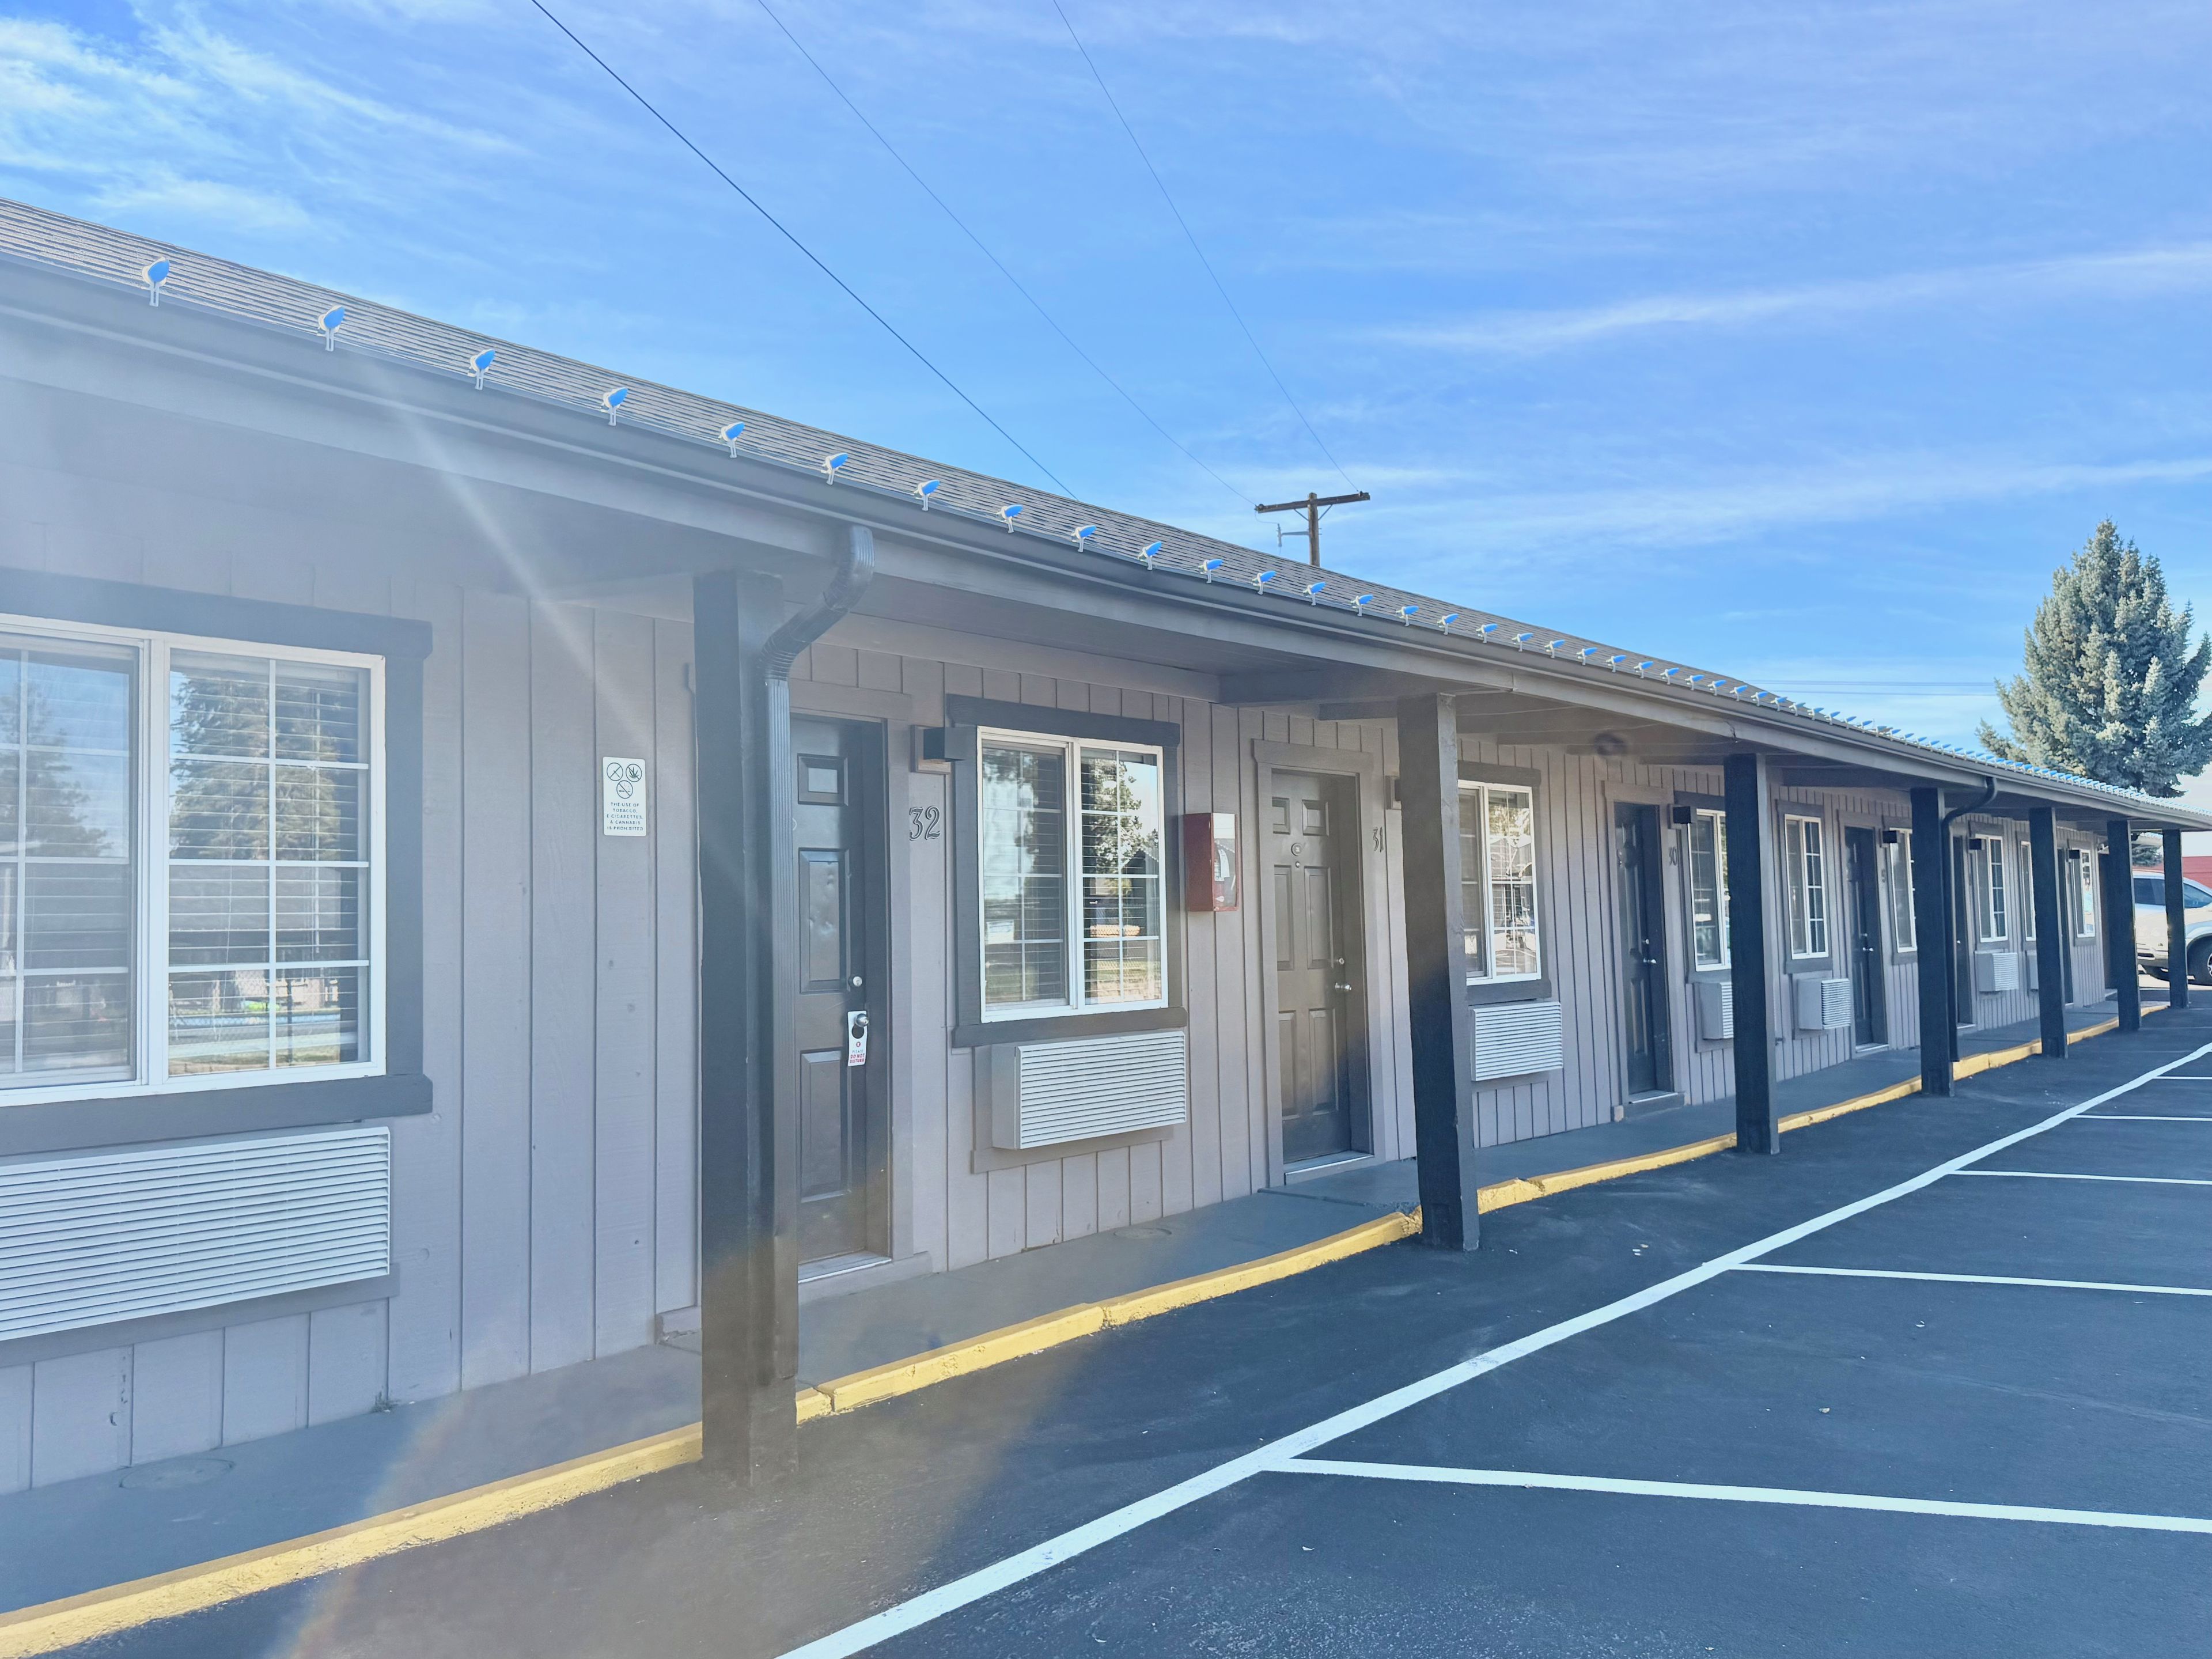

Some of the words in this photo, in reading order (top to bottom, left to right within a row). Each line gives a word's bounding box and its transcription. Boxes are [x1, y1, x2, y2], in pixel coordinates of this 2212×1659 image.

[909, 806, 941, 841] 32
[1373, 826, 1384, 853] 31
[1668, 846, 1677, 866] 30
